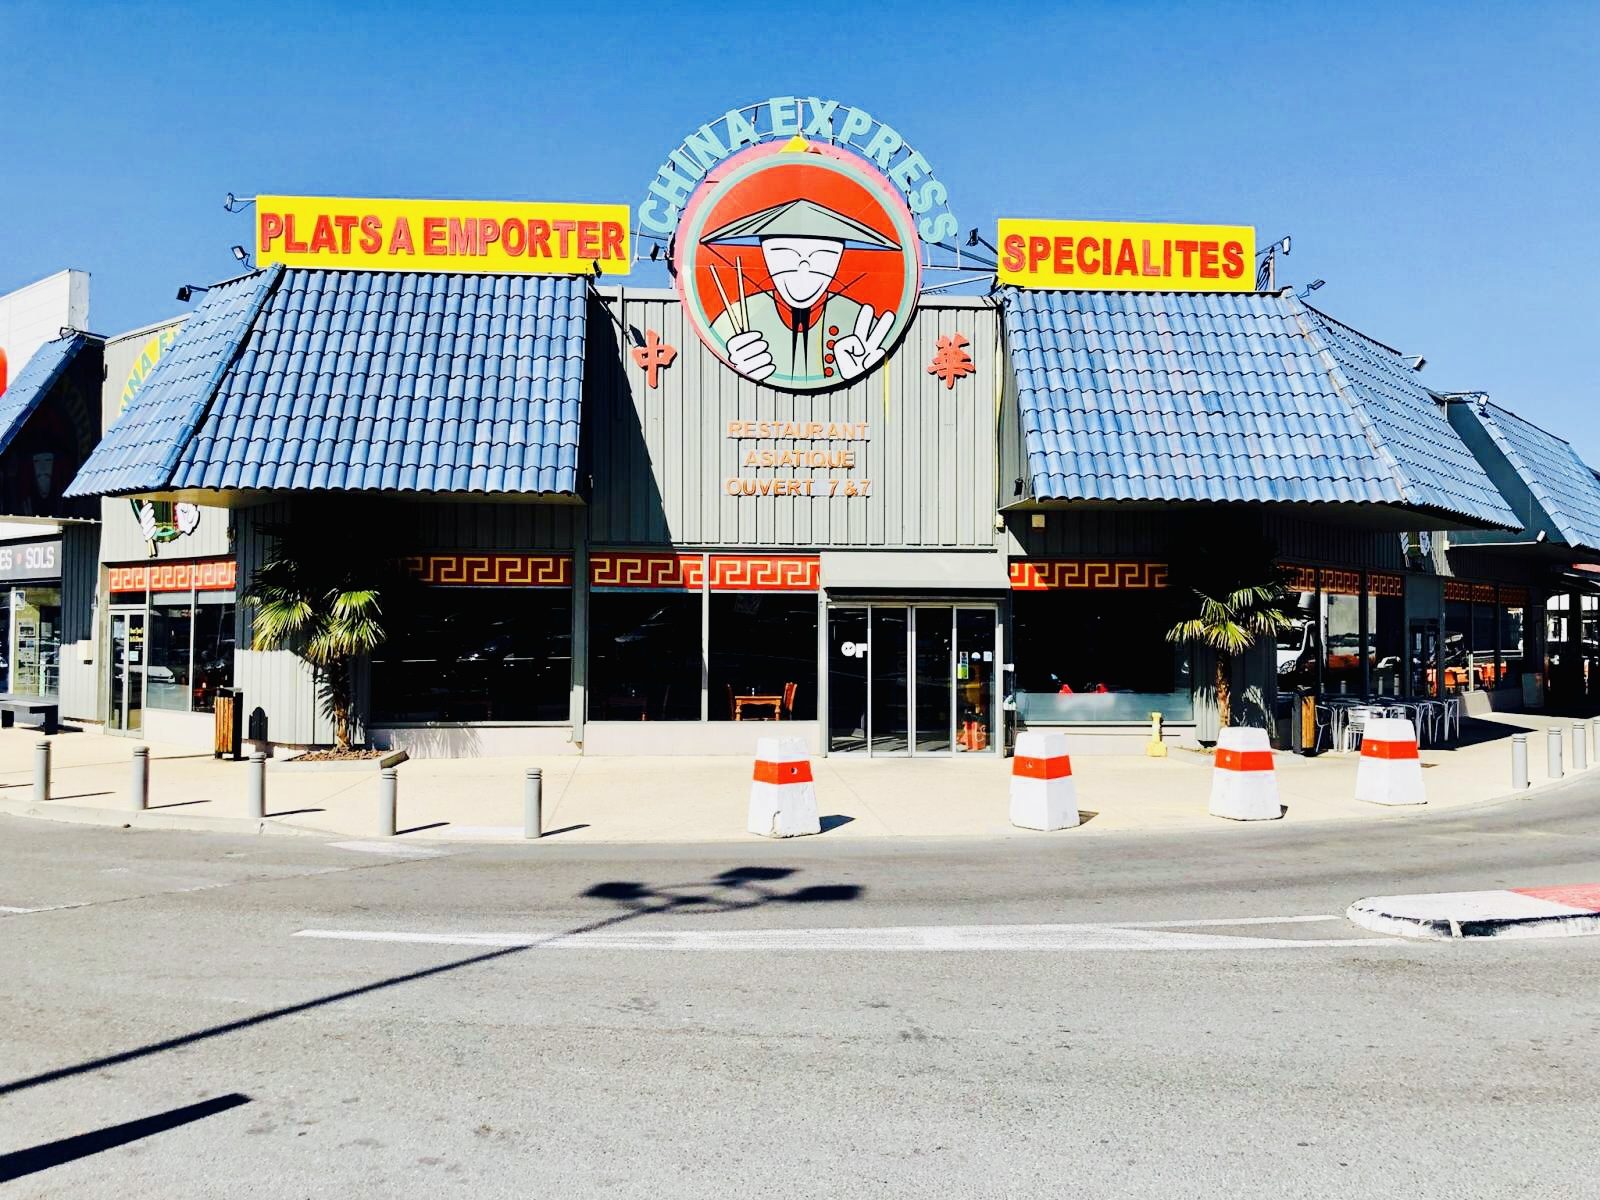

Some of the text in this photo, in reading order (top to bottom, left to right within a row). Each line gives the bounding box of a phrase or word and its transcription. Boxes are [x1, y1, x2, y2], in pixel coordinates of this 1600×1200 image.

[638, 96, 959, 244] CHINA EXPRESS
[260, 212, 626, 261] PLATS A EMPORTER
[1002, 234, 1245, 279] SPECIALITES
[631, 329, 678, 389] 中
[727, 420, 870, 439] RESTAURANT
[744, 450, 856, 468] ASIATIQUE
[725, 478, 815, 496] OUVERT
[25, 546, 55, 569] SOLS
